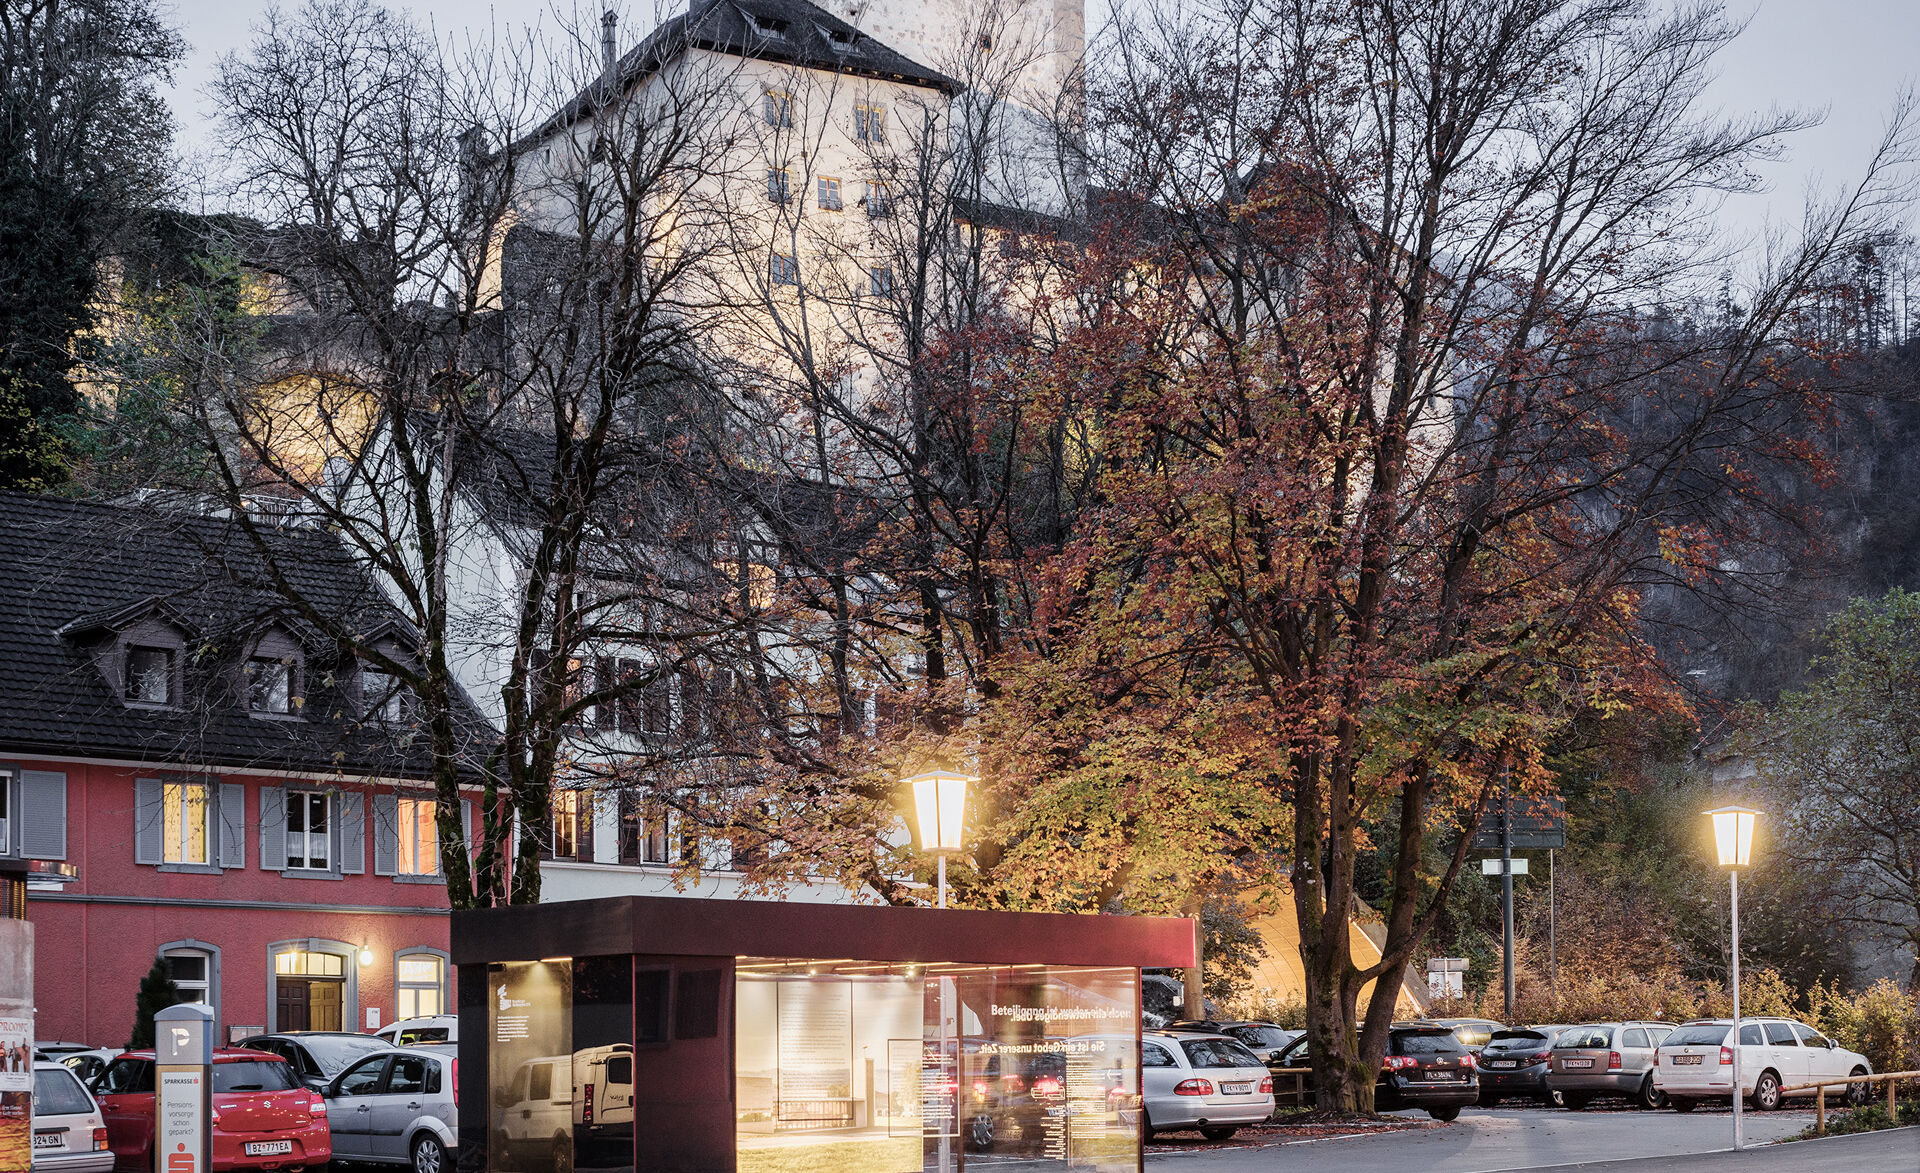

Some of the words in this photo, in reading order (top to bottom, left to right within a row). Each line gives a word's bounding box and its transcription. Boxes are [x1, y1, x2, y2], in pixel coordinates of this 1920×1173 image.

[168, 1128, 194, 1137] geparkt?
[48, 1135, 59, 1144] GN
[252, 1144, 261, 1152] BZ
